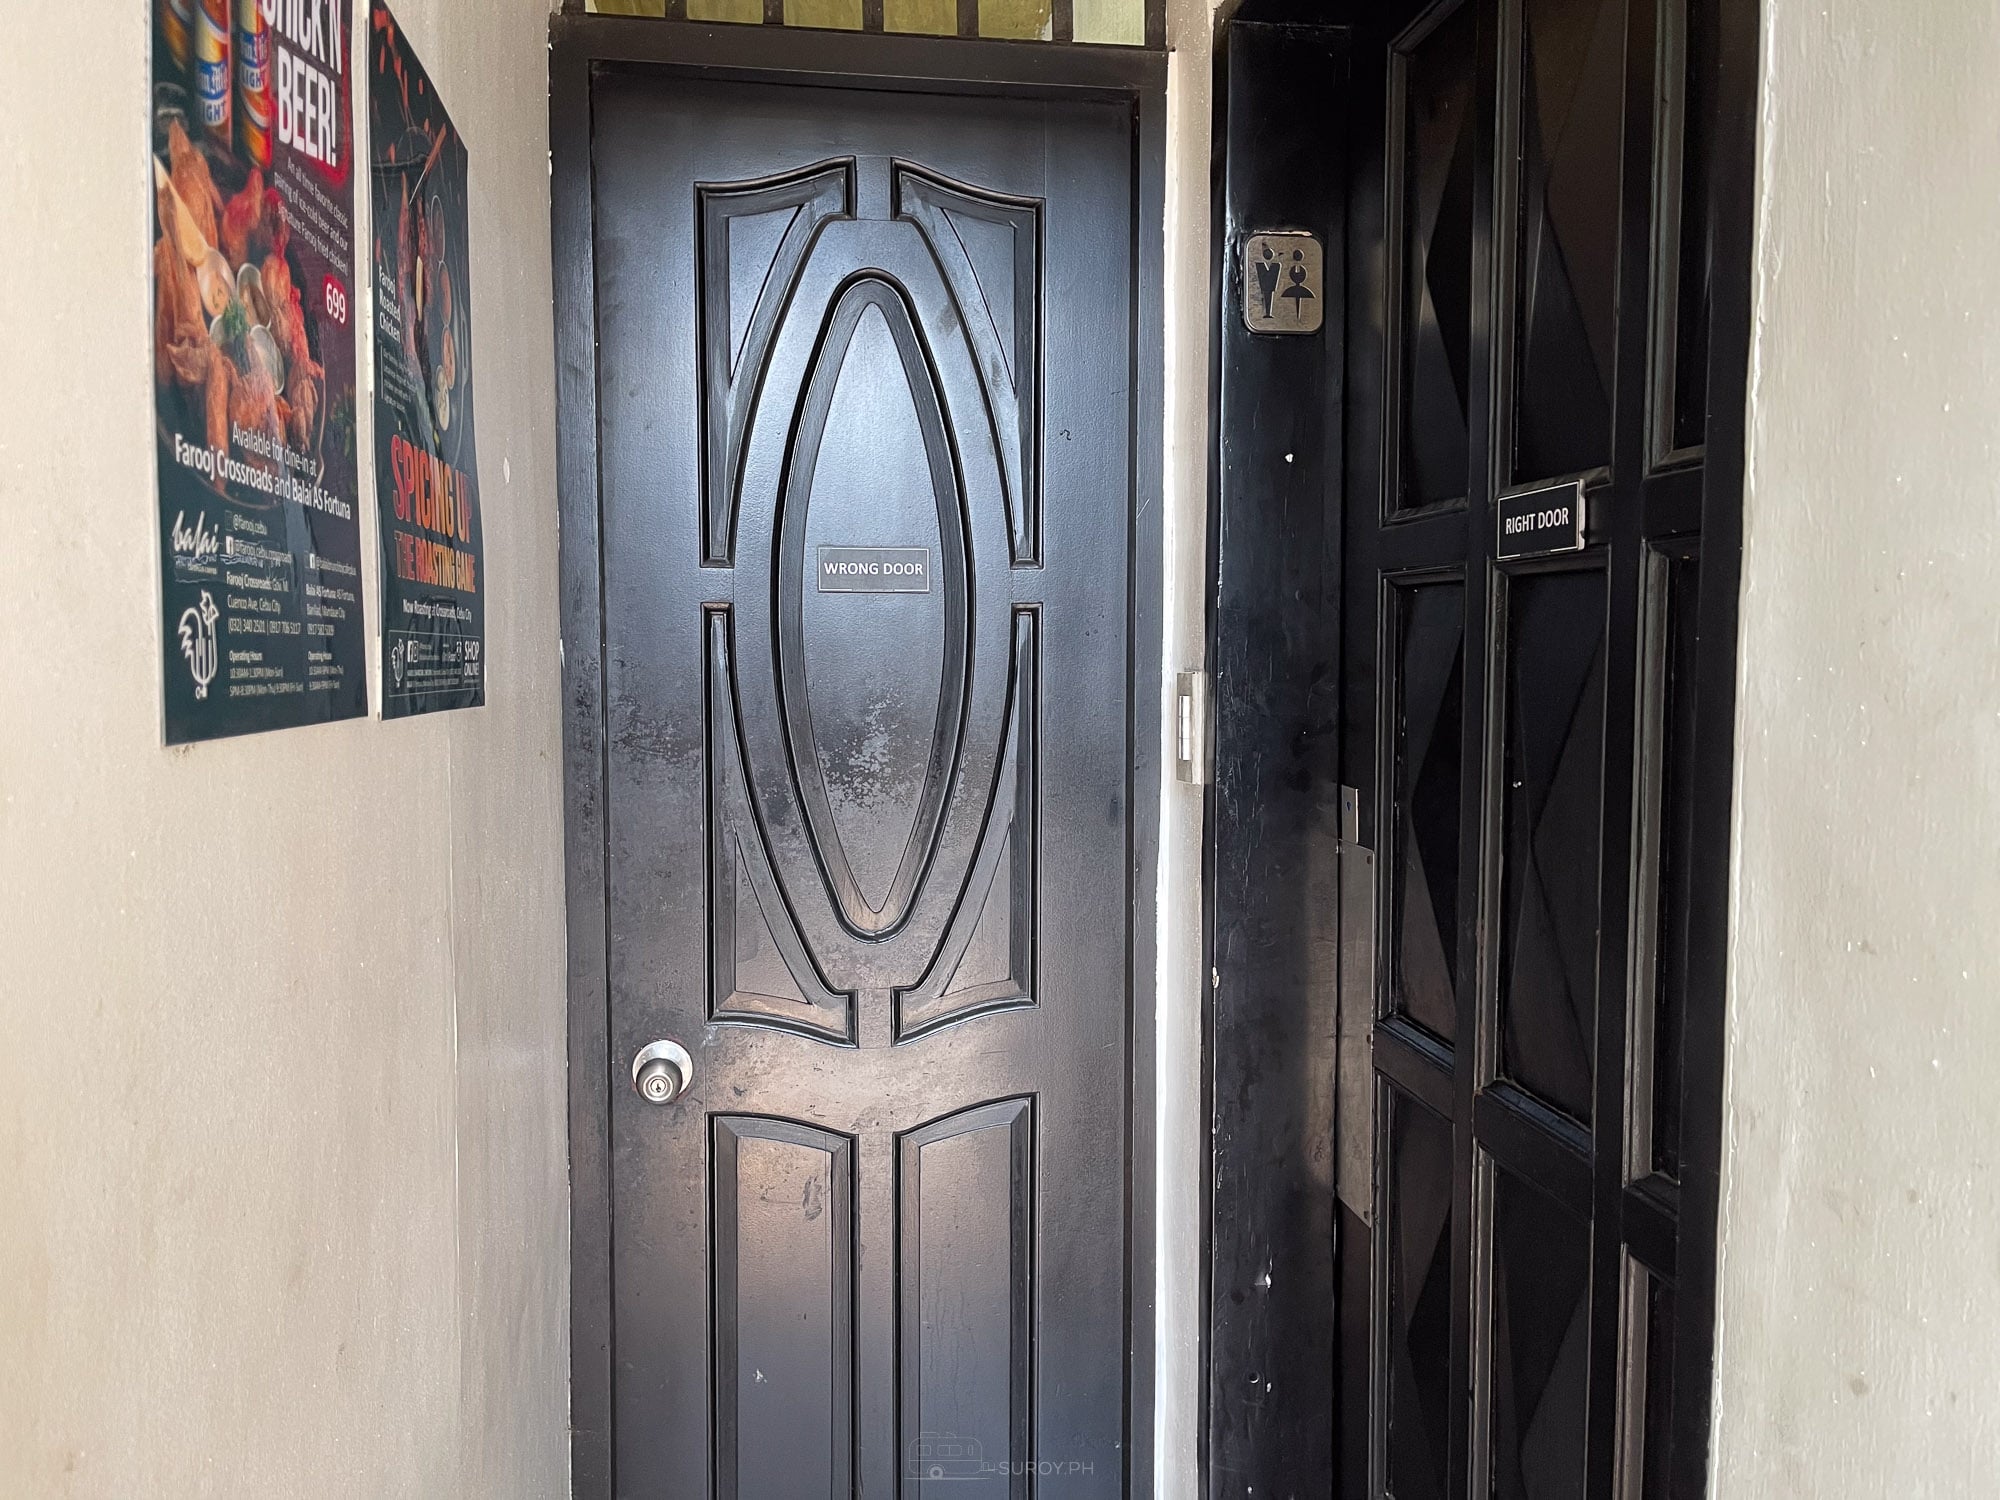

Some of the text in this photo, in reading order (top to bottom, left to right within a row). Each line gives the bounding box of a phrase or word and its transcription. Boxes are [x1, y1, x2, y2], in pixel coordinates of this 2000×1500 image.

[277, 46, 337, 168] BEER!
[330, 226, 340, 245] and
[340, 237, 348, 251] our
[326, 283, 346, 324] 699
[232, 421, 317, 477] Available for dine-in at
[174, 433, 351, 520] Farooj Crossroads and Balai AS Fortuna
[391, 434, 472, 544] SPICING UP
[1505, 507, 1569, 535] RIGHT DOOR
[394, 530, 476, 593] THE ROASTING GAME
[824, 562, 923, 575] WRONG DOOR
[464, 640, 480, 661] SHOP
